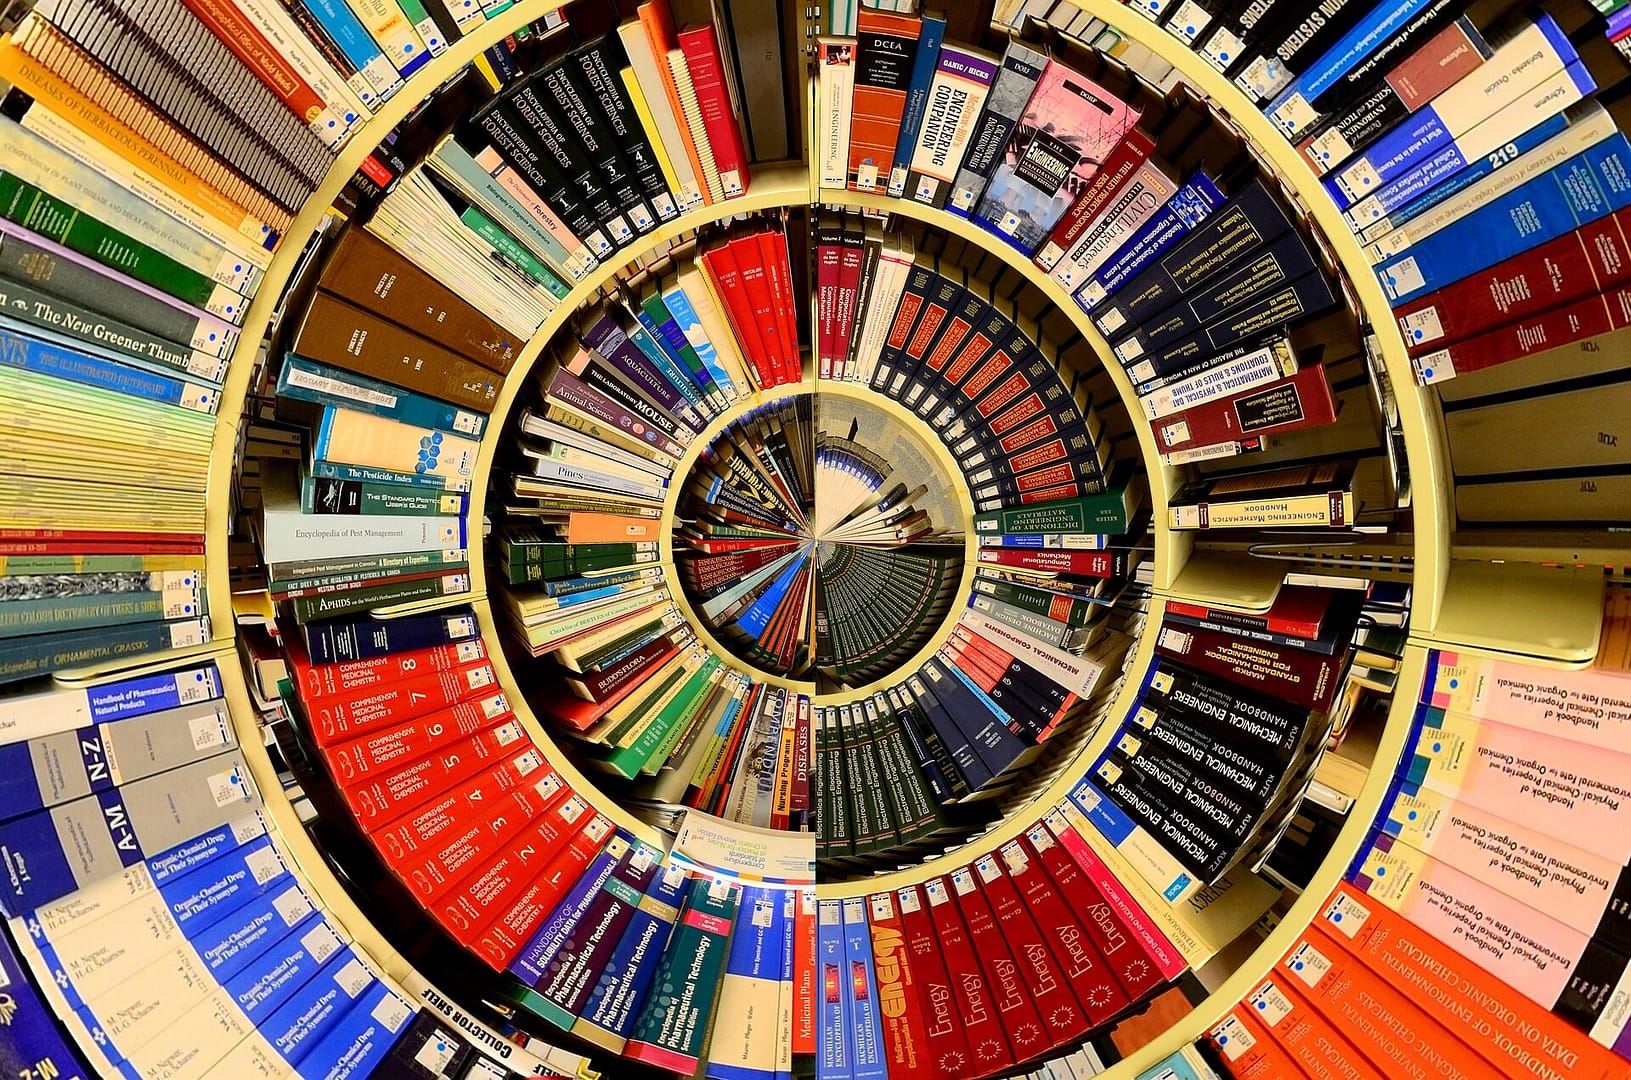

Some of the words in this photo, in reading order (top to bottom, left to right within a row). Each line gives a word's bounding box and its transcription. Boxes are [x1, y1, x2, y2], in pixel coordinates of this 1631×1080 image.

[874, 38, 902, 52] DCEA
[1274, 11, 1326, 61] SYSTEMS
[590, 50, 621, 100] ENCYCLOPEDIA
[616, 98, 626, 110] OF
[942, 58, 963, 72] GANIC
[967, 66, 991, 80] HICKS
[554, 68, 589, 116] ENCYCLOPEDIA
[585, 114, 596, 126] OF
[578, 56, 604, 93] FOREST
[598, 92, 628, 136] SCIENCES
[18, 64, 65, 101] DISEASES
[60, 93, 79, 110] OF
[77, 104, 135, 148] HERBACEOUS
[131, 141, 189, 185] PERENNIALS
[521, 88, 559, 134] ENCYCLOPEDIA
[555, 132, 566, 143] OF
[543, 75, 571, 110] FOREST
[566, 109, 599, 152] SCIENCES
[921, 84, 949, 151] COMPANION
[932, 89, 966, 167] ENGINEERING
[951, 93, 978, 149] McGraw-Hill's
[490, 109, 530, 155] ENCYCLOPEDIA
[526, 152, 537, 164] OF
[510, 95, 540, 130] FOREST
[536, 128, 572, 168] SCIENCES
[480, 117, 512, 150] FOREST
[509, 148, 546, 186] SCIENCES
[1025, 143, 1071, 178] ENGINEERING
[1118, 160, 1133, 175] THE
[1488, 142, 1520, 168] 219
[1093, 172, 1110, 190] DESK
[1105, 171, 1124, 192] WILEY
[1070, 186, 1098, 219] REFERENCE
[1087, 188, 1110, 213] PROJECT
[1105, 183, 1142, 223] ILLUSTRATED
[530, 204, 559, 232] Forestry
[1142, 218, 1170, 245] Ergonomics
[1157, 222, 1182, 246] Handbook
[1167, 214, 1176, 223] in
[1071, 222, 1106, 260] SOURCEBOOK
[1074, 221, 1127, 274] Engineer's
[1130, 246, 1155, 269] Standards
[1133, 241, 1145, 253] and
[1151, 241, 1160, 251] of
[1103, 262, 1122, 281] Factors
[1118, 249, 1136, 267] Human
[1120, 265, 1133, 277] and
[819, 286, 827, 320] Mechanics
[824, 287, 833, 335] Computational
[836, 288, 846, 322] Mechanics
[839, 289, 852, 337] Computational
[31, 301, 63, 326] The
[60, 311, 94, 336] New
[90, 322, 147, 355] Greener
[144, 341, 191, 371] Thumb
[620, 353, 673, 401] AQUACULTURE
[1202, 370, 1224, 386] RULES
[1223, 367, 1231, 378] &
[1230, 353, 1270, 376] EQUATIONS
[1170, 380, 1194, 398] THUMB
[1193, 377, 1203, 389] OF
[554, 385, 588, 409] Animal
[584, 401, 616, 423] Science
[634, 400, 675, 432] MOUSE
[348, 468, 360, 479] The
[361, 470, 392, 483] Pesticide
[393, 473, 412, 485] Index
[556, 464, 585, 482] Pines
[296, 528, 339, 539] Encyclopedia
[341, 528, 348, 538] of
[350, 528, 362, 538] Pest
[364, 528, 402, 538] Management
[319, 595, 350, 610] APHIDS
[983, 620, 1032, 650] COMPONENTS
[1231, 641, 1279, 660] ENGINEERS
[338, 657, 389, 673] COMPREHENSIVE
[597, 667, 624, 689] BUDD'S
[620, 652, 647, 674] FLORA
[1031, 645, 1080, 675] MECHANICAL
[1204, 649, 1250, 669] HANDBOOK
[1216, 644, 1270, 666] MECHANICAL
[1272, 660, 1291, 672] FOR
[341, 668, 375, 680] MEDICINAL
[343, 675, 375, 688] CHEMISTRY
[376, 674, 381, 682] II
[1252, 663, 1301, 684] STANDARD
[92, 692, 125, 707] Handbook
[125, 691, 132, 701] of
[132, 682, 176, 700] Pharmaceutical
[94, 704, 118, 717] Natural
[119, 698, 147, 712] Products
[1168, 688, 1227, 722] ENGINEERS'
[1225, 712, 1282, 746] MECHANICAL
[1233, 699, 1288, 728] HANDBOOK
[1148, 723, 1204, 762] ENGINEERS'
[1284, 725, 1299, 749] KUTZ
[80, 737, 106, 782] N-Z
[780, 739, 792, 777] Programs
[798, 726, 808, 782] DISEASES
[1201, 754, 1257, 792] MECHANICAL
[776, 780, 787, 811] Nursing
[104, 803, 137, 853] A-M
[1450, 814, 1487, 837] Chemicals
[1460, 830, 1473, 843] and
[1486, 830, 1518, 851] Organic
[150, 839, 207, 871] Organic-Chemical
[205, 830, 226, 847] Drugs
[154, 867, 169, 880] and
[169, 858, 187, 874] Their
[186, 844, 218, 866] Synonyms
[1472, 835, 1512, 861] Properties
[1488, 857, 1498, 869] of
[1518, 843, 1529, 855] for
[1528, 848, 1547, 863] Fate
[1498, 862, 1542, 889] Handbook
[1511, 854, 1585, 895] Physical-Chemical
[1549, 857, 1609, 890] Environmental
[536, 933, 565, 968] SOLUBILITY
[560, 918, 576, 935] DATA
[571, 908, 582, 921] for
[577, 859, 619, 911] PHARMACEUTICALS
[1085, 898, 1128, 955] Energy
[527, 915, 567, 962] HANDBOOK
[562, 903, 577, 919] OF
[552, 942, 596, 1003] Pharmaceutical
[589, 900, 622, 944] Technology
[1055, 921, 1093, 978] Energy
[1394, 937, 1460, 988] CHEMICALS
[544, 960, 571, 996] Encyclopedia
[566, 953, 576, 962] of
[600, 964, 637, 1027] Pharmaceutical
[630, 918, 659, 964] Technology
[800, 970, 810, 993] Plants
[992, 957, 1022, 1011] Energy
[1022, 939, 1058, 997] Energy
[421, 989, 454, 1016] SHELF
[564, 988, 581, 1009] Second
[576, 967, 593, 989] Edition
[666, 981, 696, 1047] Pharmaceutical
[687, 934, 711, 980] Technology
[959, 971, 988, 1026] Energy
[1458, 980, 1517, 1026] ORGANIC
[800, 997, 810, 1038] Medicinal
[928, 983, 952, 1036] Energy
[453, 1011, 512, 1059] COLLECTOR
[1516, 1020, 1542, 1042] ON
[1538, 1035, 1578, 1067] DATA
